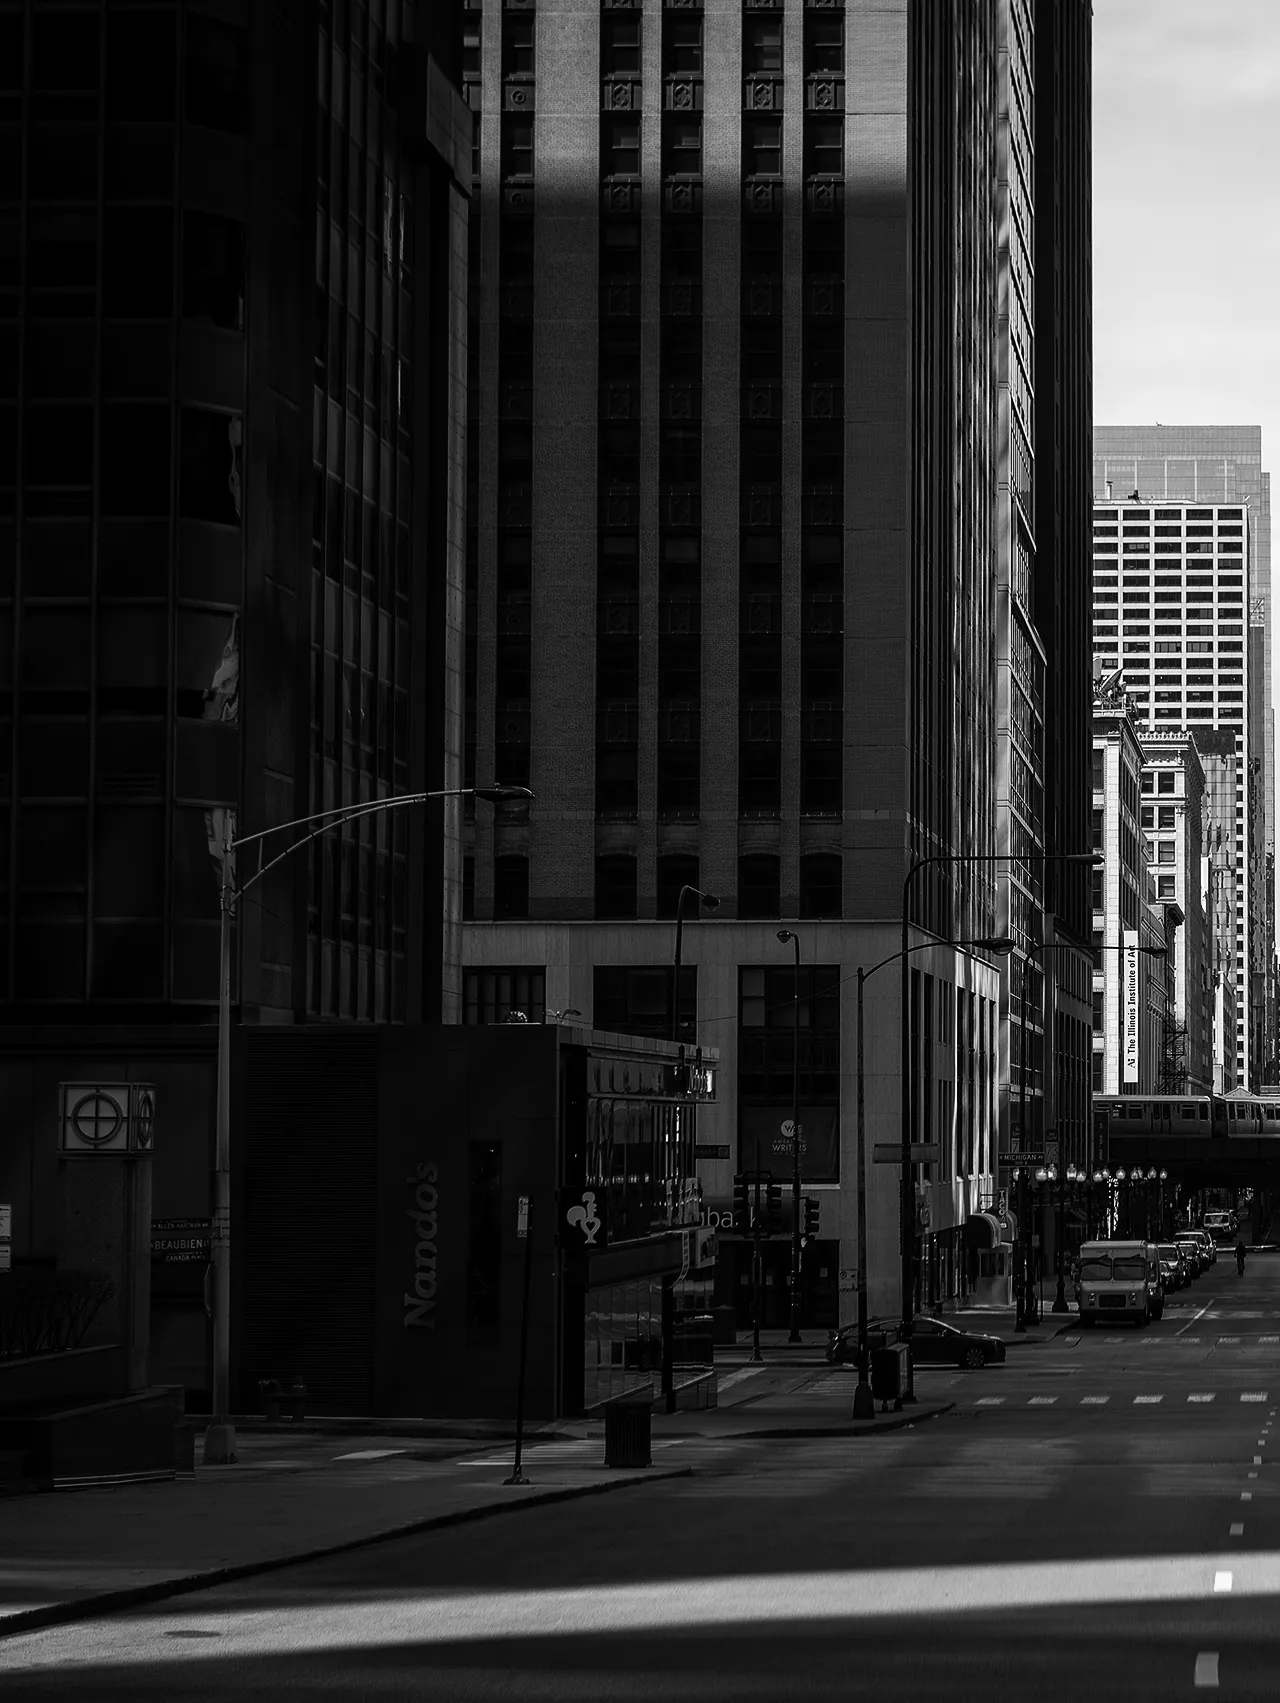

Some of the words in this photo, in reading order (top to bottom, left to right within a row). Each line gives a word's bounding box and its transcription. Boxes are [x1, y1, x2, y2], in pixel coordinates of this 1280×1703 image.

[1127, 960, 1136, 969] of
[1127, 970, 1136, 1006] Institute
[1127, 1008, 1136, 1037] Illinois
[1127, 1039, 1136, 1055] The
[772, 1144, 807, 1152] WRITRS
[154, 1239, 203, 1250] BEAUBIEN
[404, 1161, 439, 1332] Nando's
